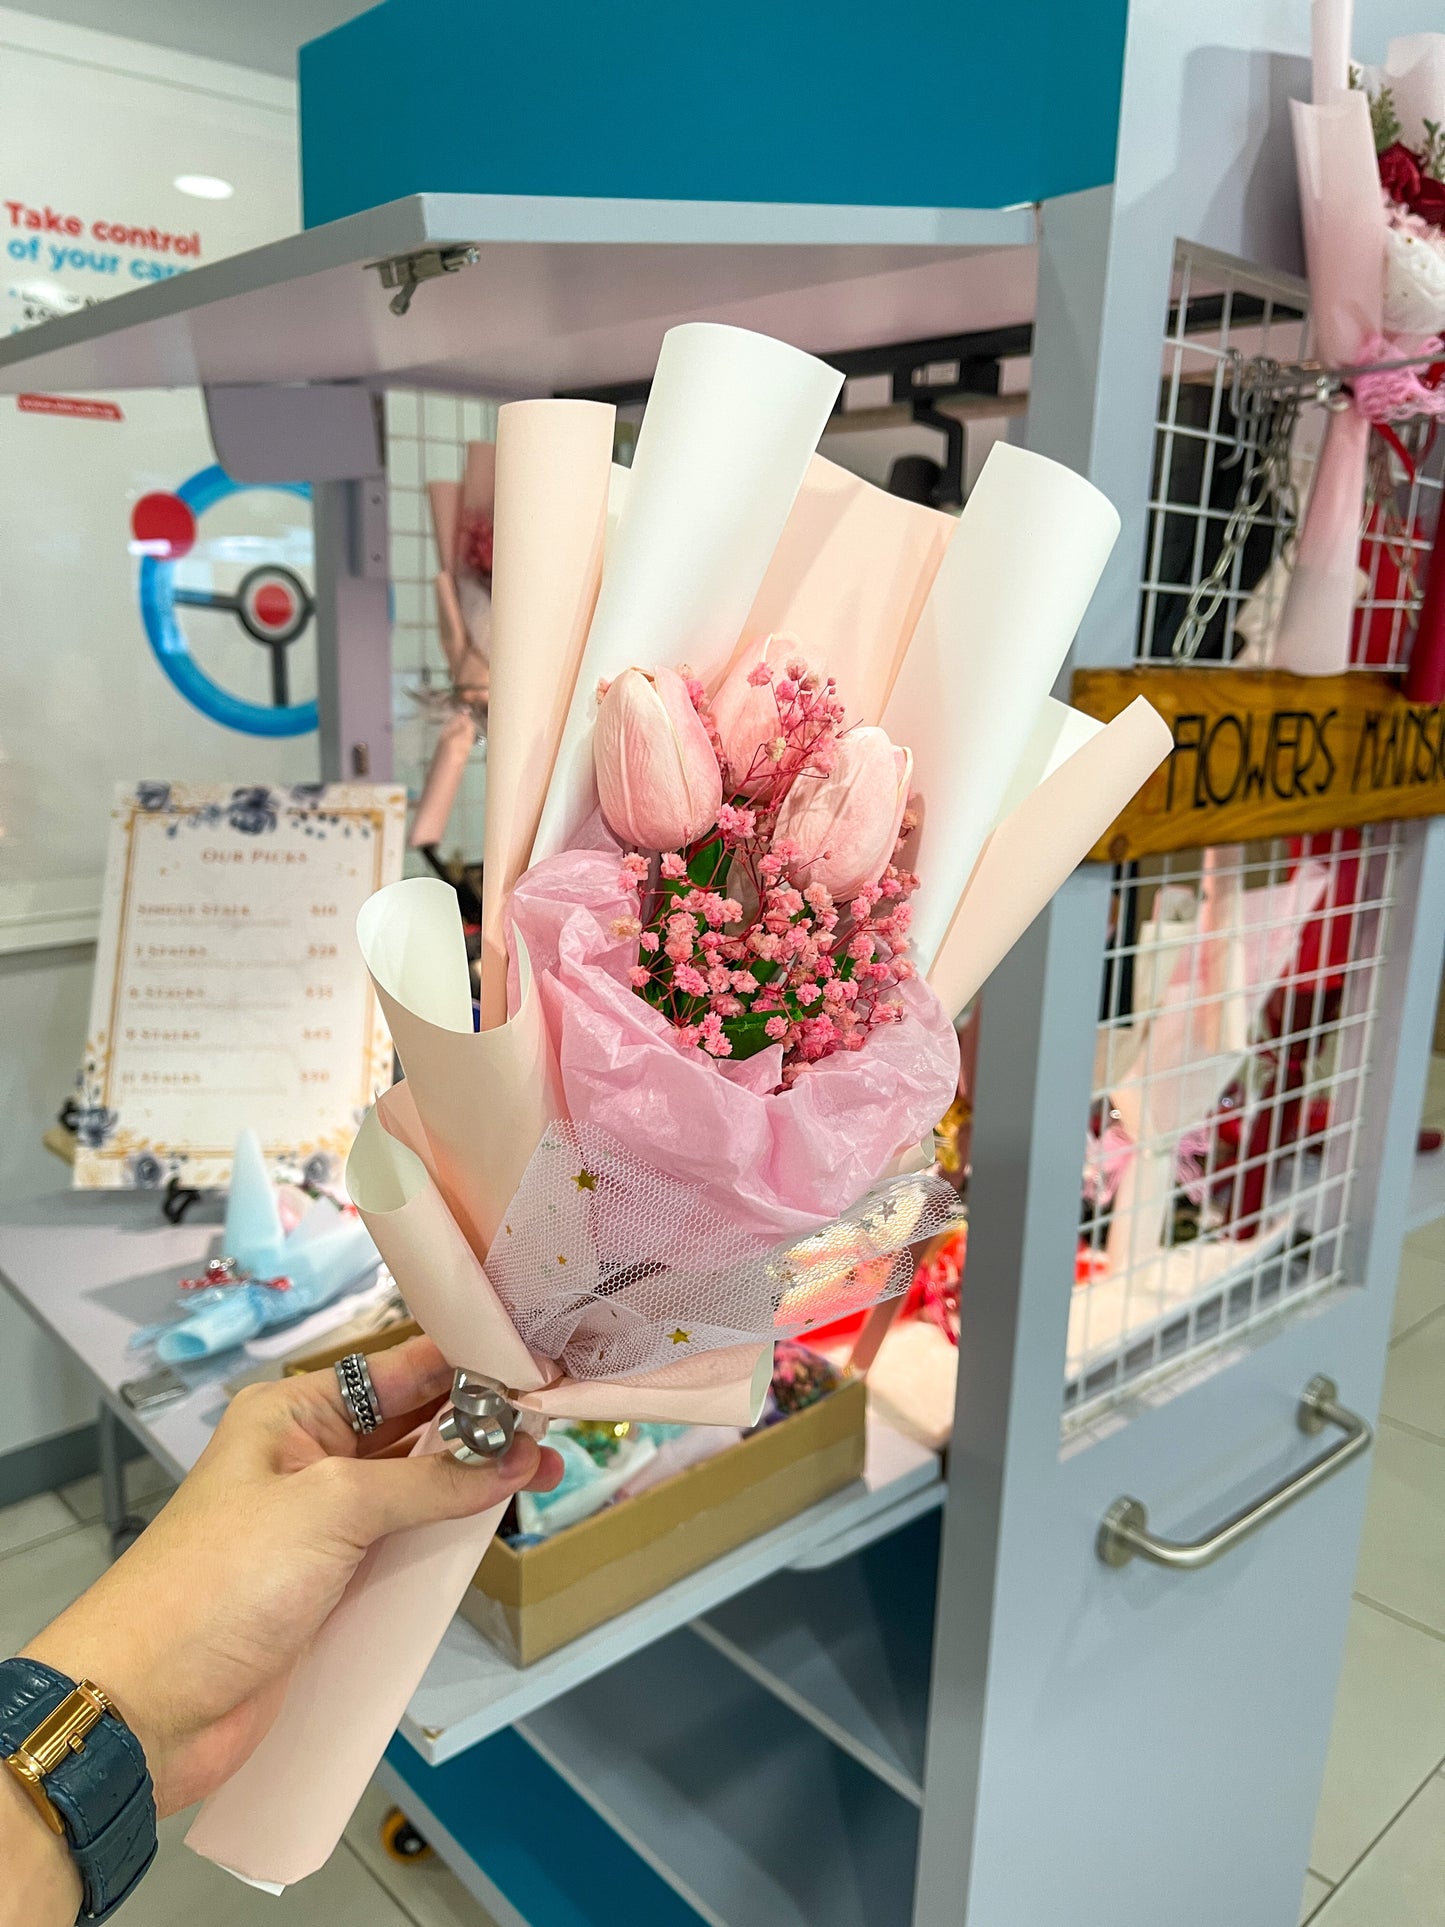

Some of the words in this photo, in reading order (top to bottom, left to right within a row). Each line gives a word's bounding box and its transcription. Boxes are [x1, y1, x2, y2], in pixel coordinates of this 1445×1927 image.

[5, 201, 82, 237] Take
[91, 221, 201, 257] control
[7, 236, 40, 260] of
[48, 245, 119, 274] your
[1166, 709, 1337, 812] FLOWERS
